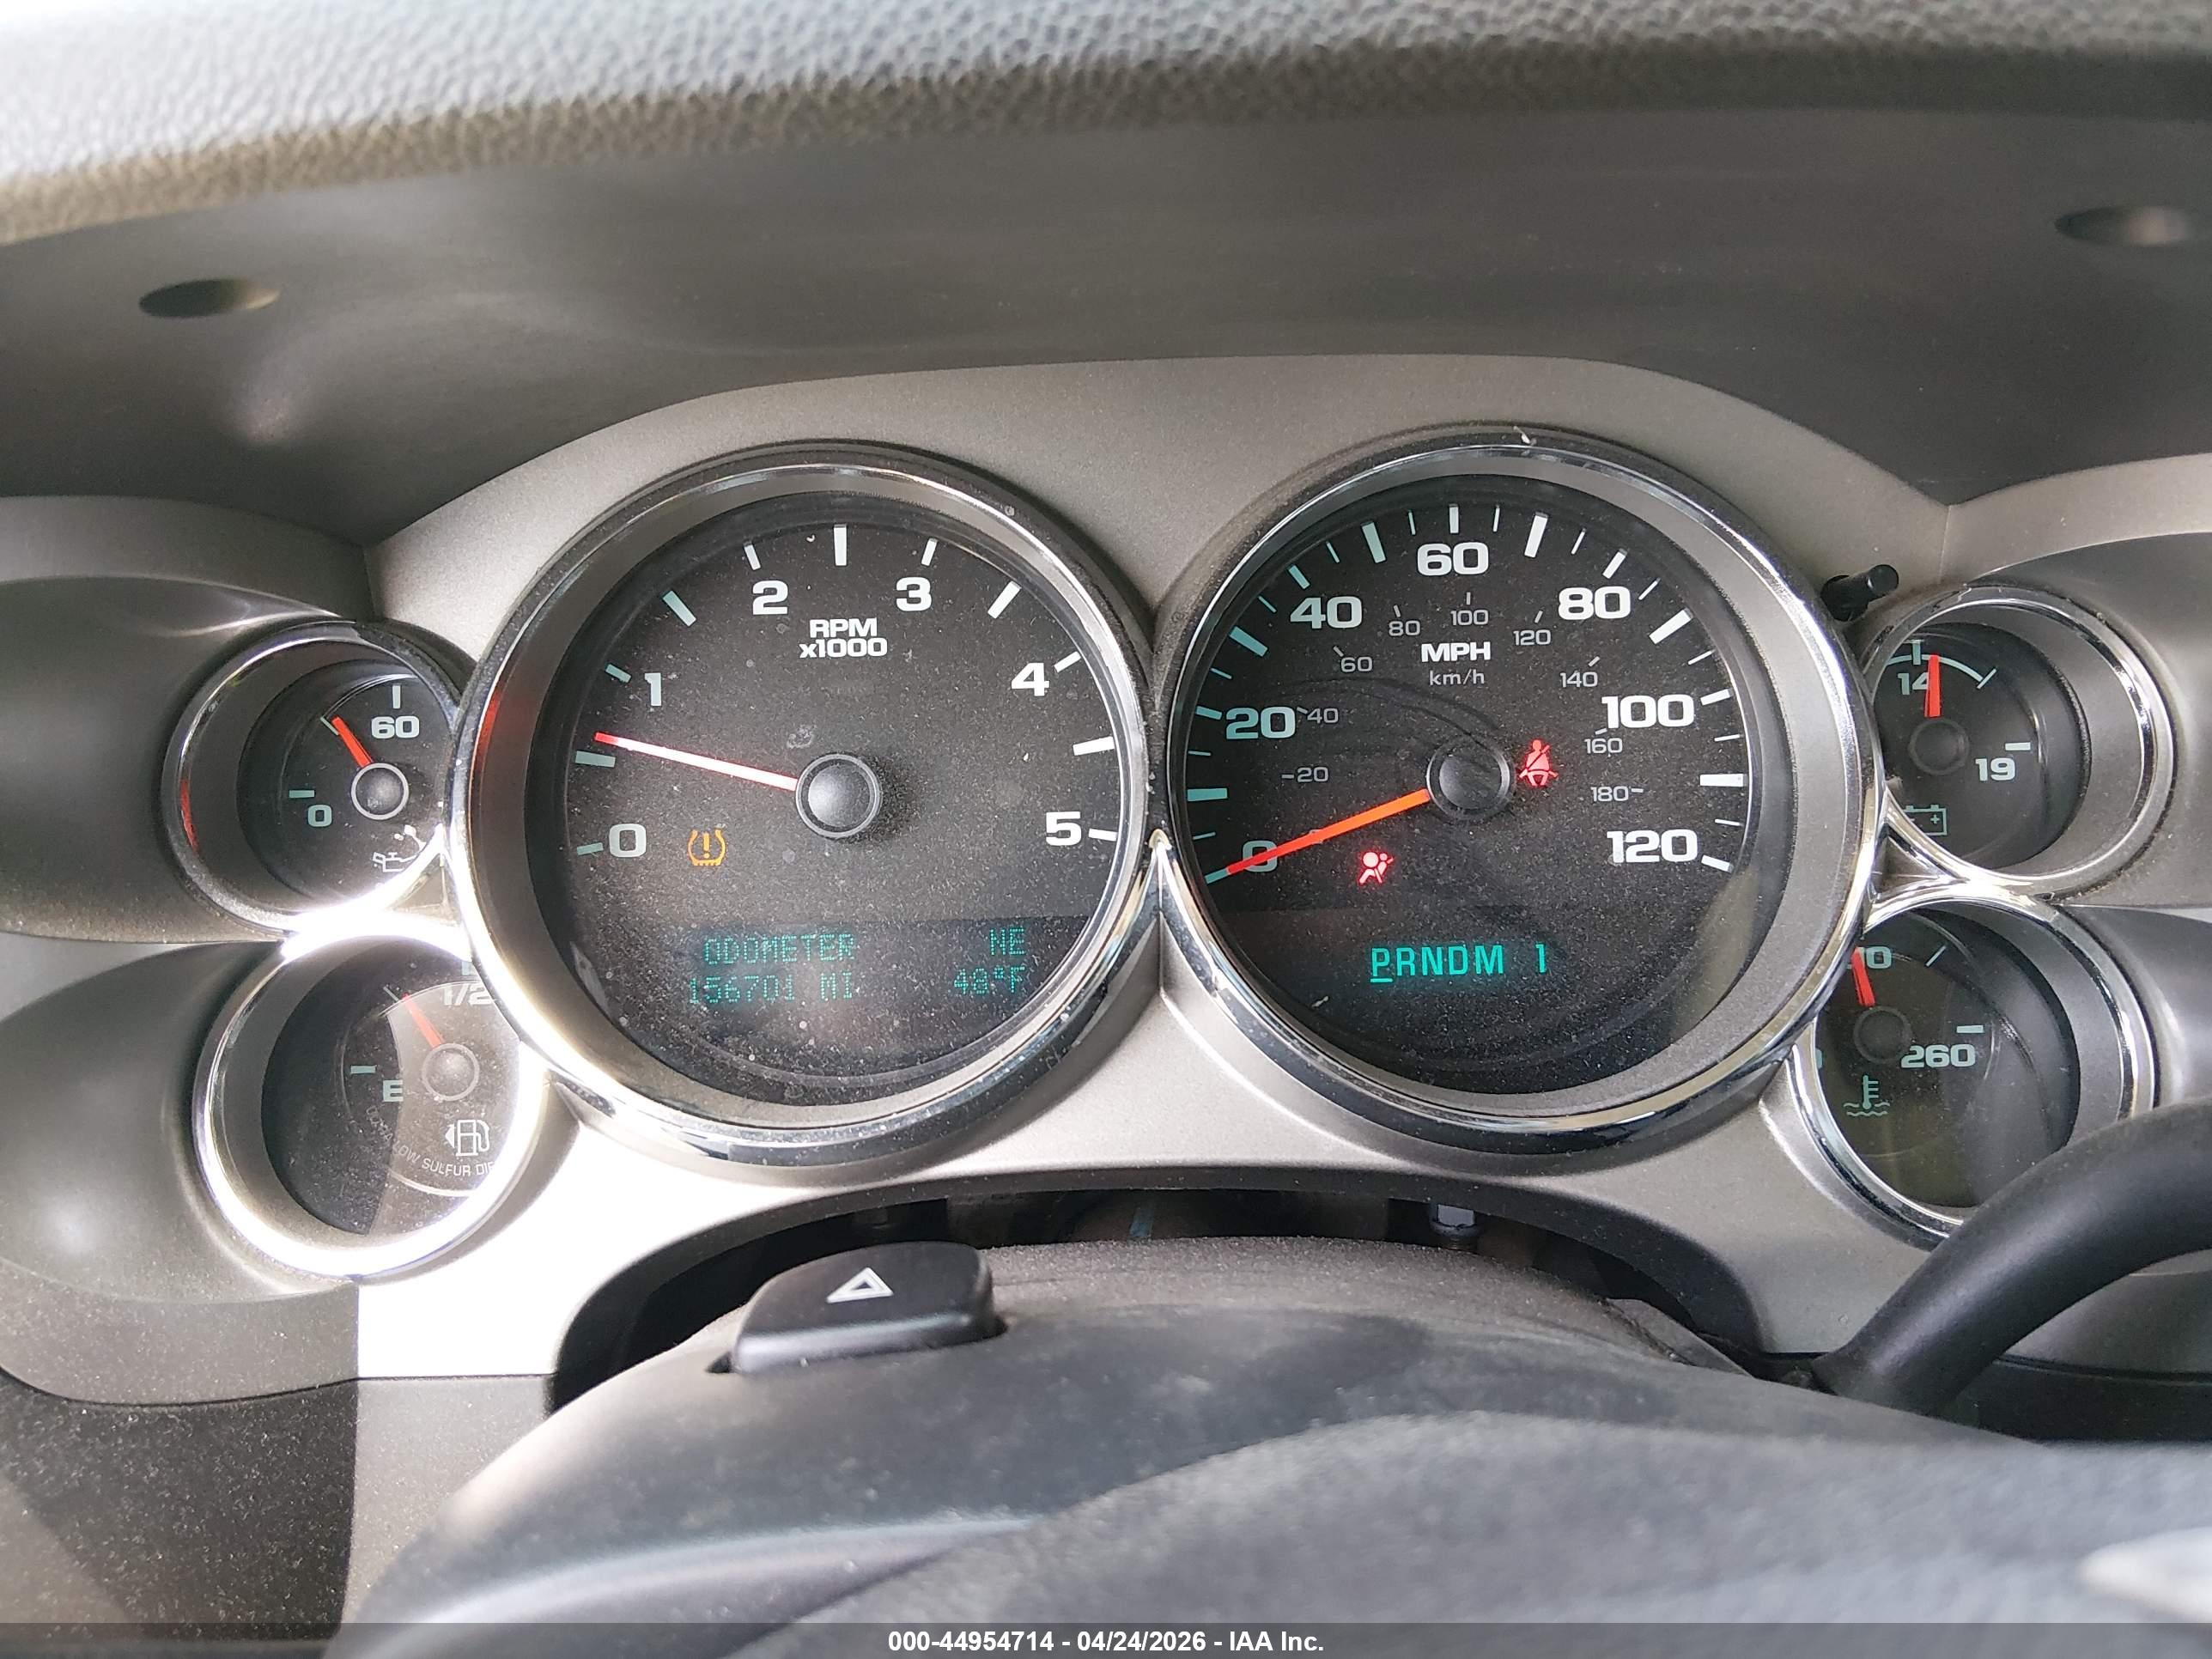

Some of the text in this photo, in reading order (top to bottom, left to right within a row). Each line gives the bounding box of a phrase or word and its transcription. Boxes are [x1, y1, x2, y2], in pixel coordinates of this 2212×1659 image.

[1418, 542, 1488, 575] 60
[753, 580, 787, 615] 2
[896, 577, 932, 611] 3
[1559, 586, 1631, 620] 80
[1291, 597, 1362, 629] 40
[1451, 610, 1488, 625] 100
[810, 618, 878, 638] RPM
[1389, 621, 1420, 635] 80
[1514, 629, 1551, 645] 120
[799, 638, 887, 658] x1000
[1422, 641, 1491, 662] MPH
[1341, 657, 1372, 672] 60
[1012, 663, 1049, 696] 4
[1430, 669, 1484, 685] km/h
[1560, 671, 1597, 687] 140
[645, 673, 661, 706] 1
[1227, 707, 1295, 738] 20
[1307, 708, 1338, 723] 40
[1601, 695, 1694, 728] 100
[372, 716, 419, 738] 60
[1585, 738, 1622, 753] 160
[1297, 767, 1328, 782] 20
[1976, 758, 2015, 781] 19
[1591, 786, 1628, 801] 180
[308, 805, 331, 826] 0
[610, 823, 647, 857] 0
[1046, 811, 1081, 846] 5
[1607, 830, 1698, 863] 120
[705, 933, 855, 965] ODOMETER
[989, 929, 1025, 955] NE
[1370, 945, 1547, 982] PRNDM 1
[690, 971, 853, 1004] 156701 MI
[1901, 1044, 1975, 1067] 260
[383, 1079, 404, 1102] E
[392, 1139, 422, 1163] LOW
[422, 1158, 471, 1177] SULFUR
